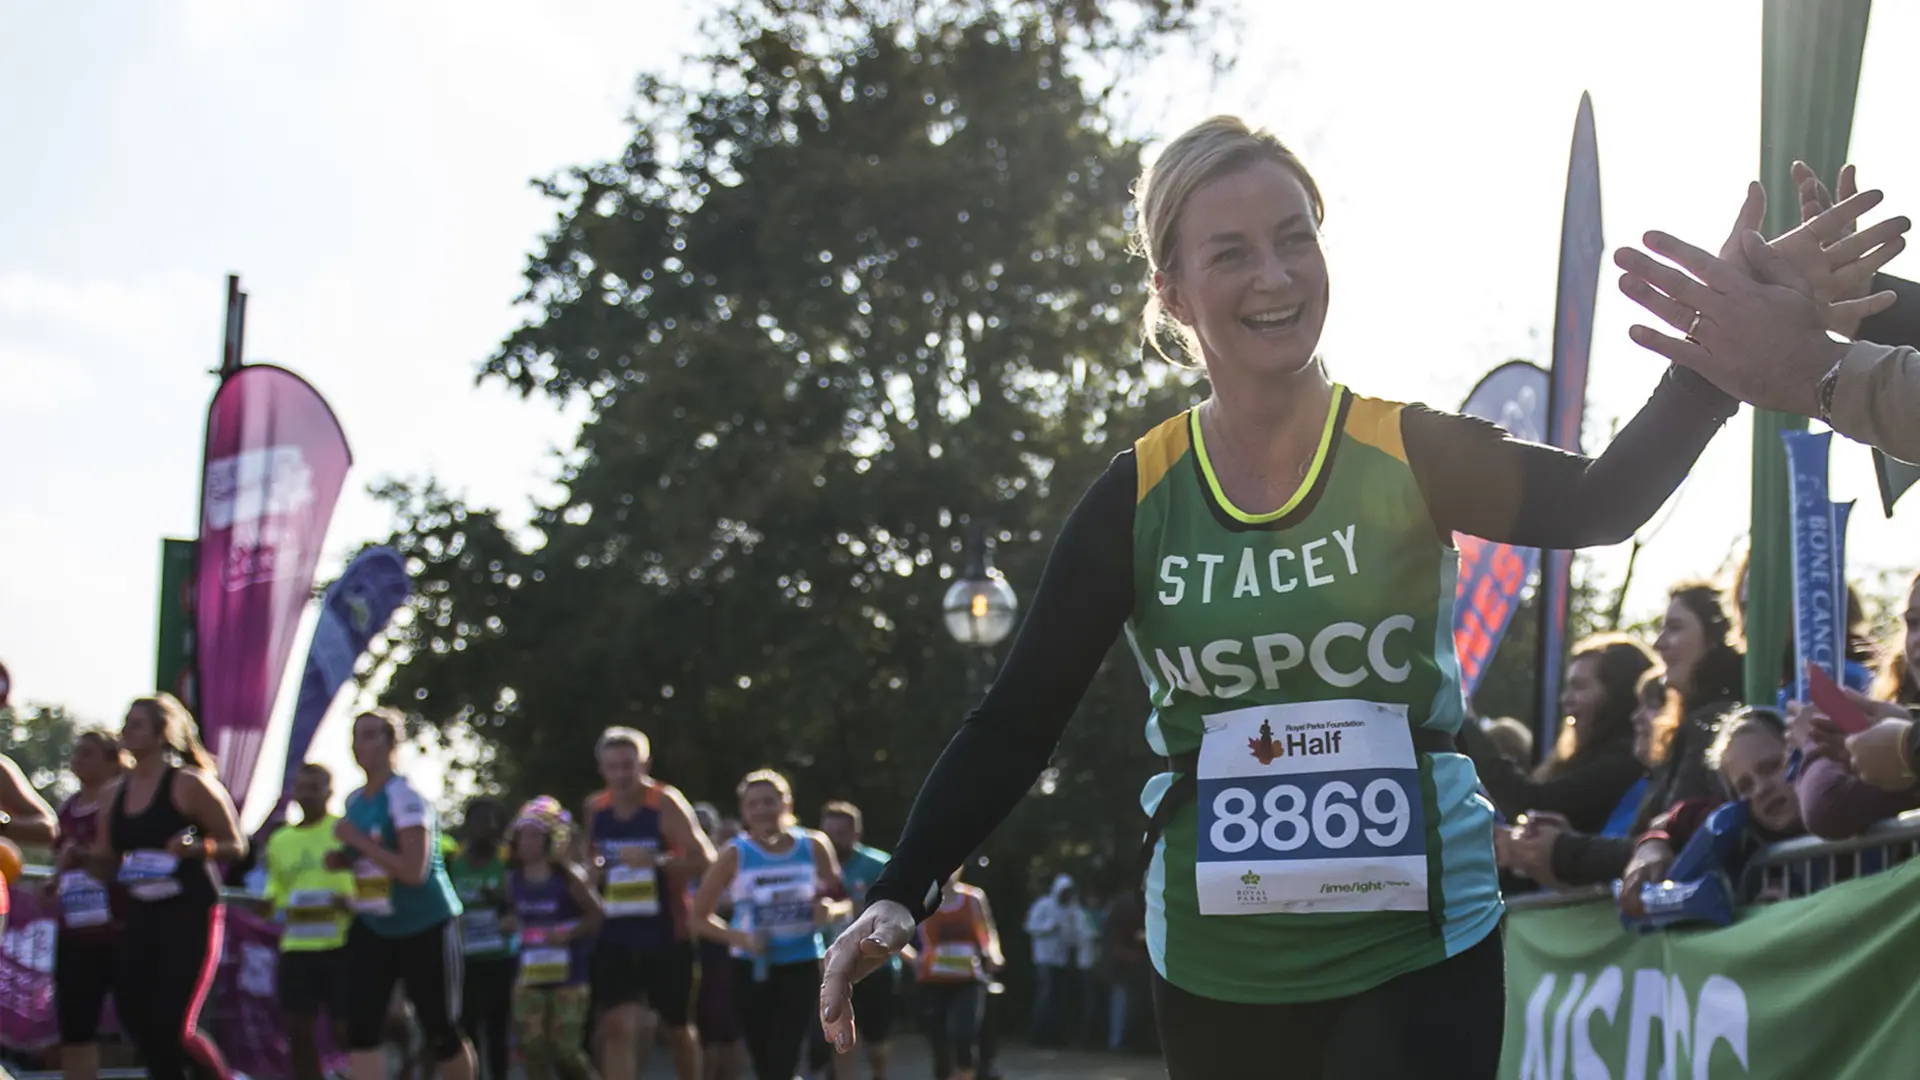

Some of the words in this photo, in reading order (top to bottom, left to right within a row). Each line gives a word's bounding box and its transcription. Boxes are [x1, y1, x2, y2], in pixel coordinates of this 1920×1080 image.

[1158, 523, 1358, 606] STACEY
[1807, 514, 1831, 583] BONE
[1154, 614, 1415, 707] NSPCC
[1285, 724, 1305, 732] Royal
[1306, 722, 1325, 730] Parks
[1326, 720, 1365, 729] Foundation
[1286, 730, 1342, 757] Half
[1209, 777, 1411, 853] 8869
